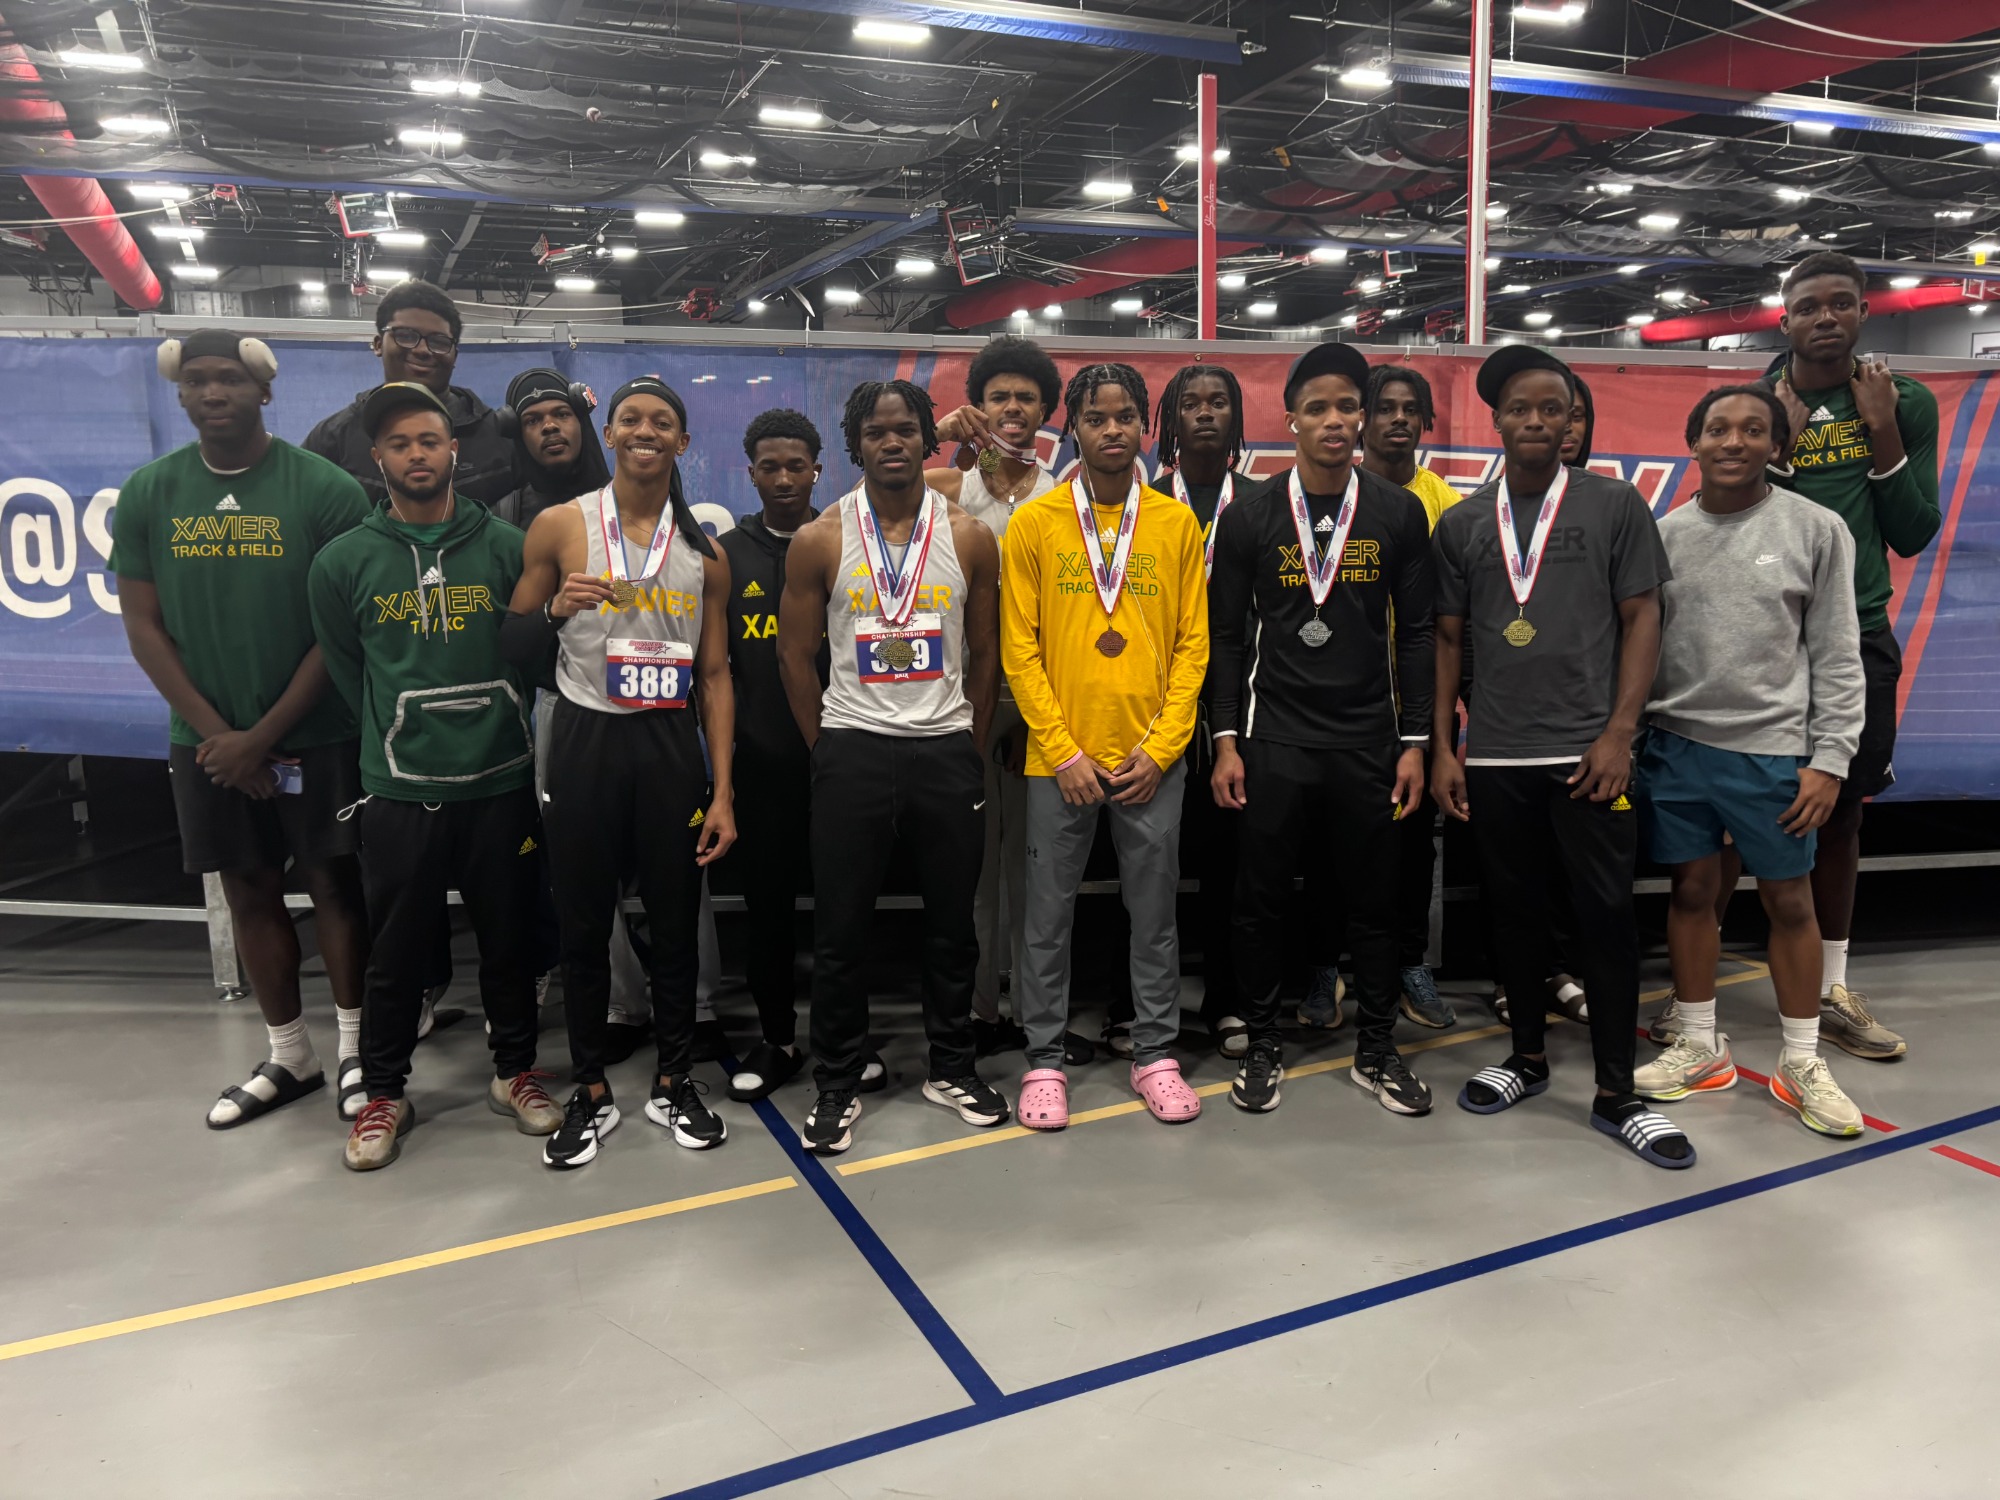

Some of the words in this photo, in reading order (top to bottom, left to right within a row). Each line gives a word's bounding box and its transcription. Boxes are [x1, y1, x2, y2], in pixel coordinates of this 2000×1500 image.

[1826, 451, 1838, 463] &
[171, 515, 282, 542] XAVIER
[171, 544, 223, 558] TRACK
[226, 544, 237, 556] &
[240, 543, 284, 557] FIELD
[1341, 569, 1380, 582] FIELD
[1057, 582, 1097, 595] TRAC
[623, 656, 677, 665] CHAMPIONSHIP
[869, 638, 930, 673] 39
[620, 664, 679, 699] 388
